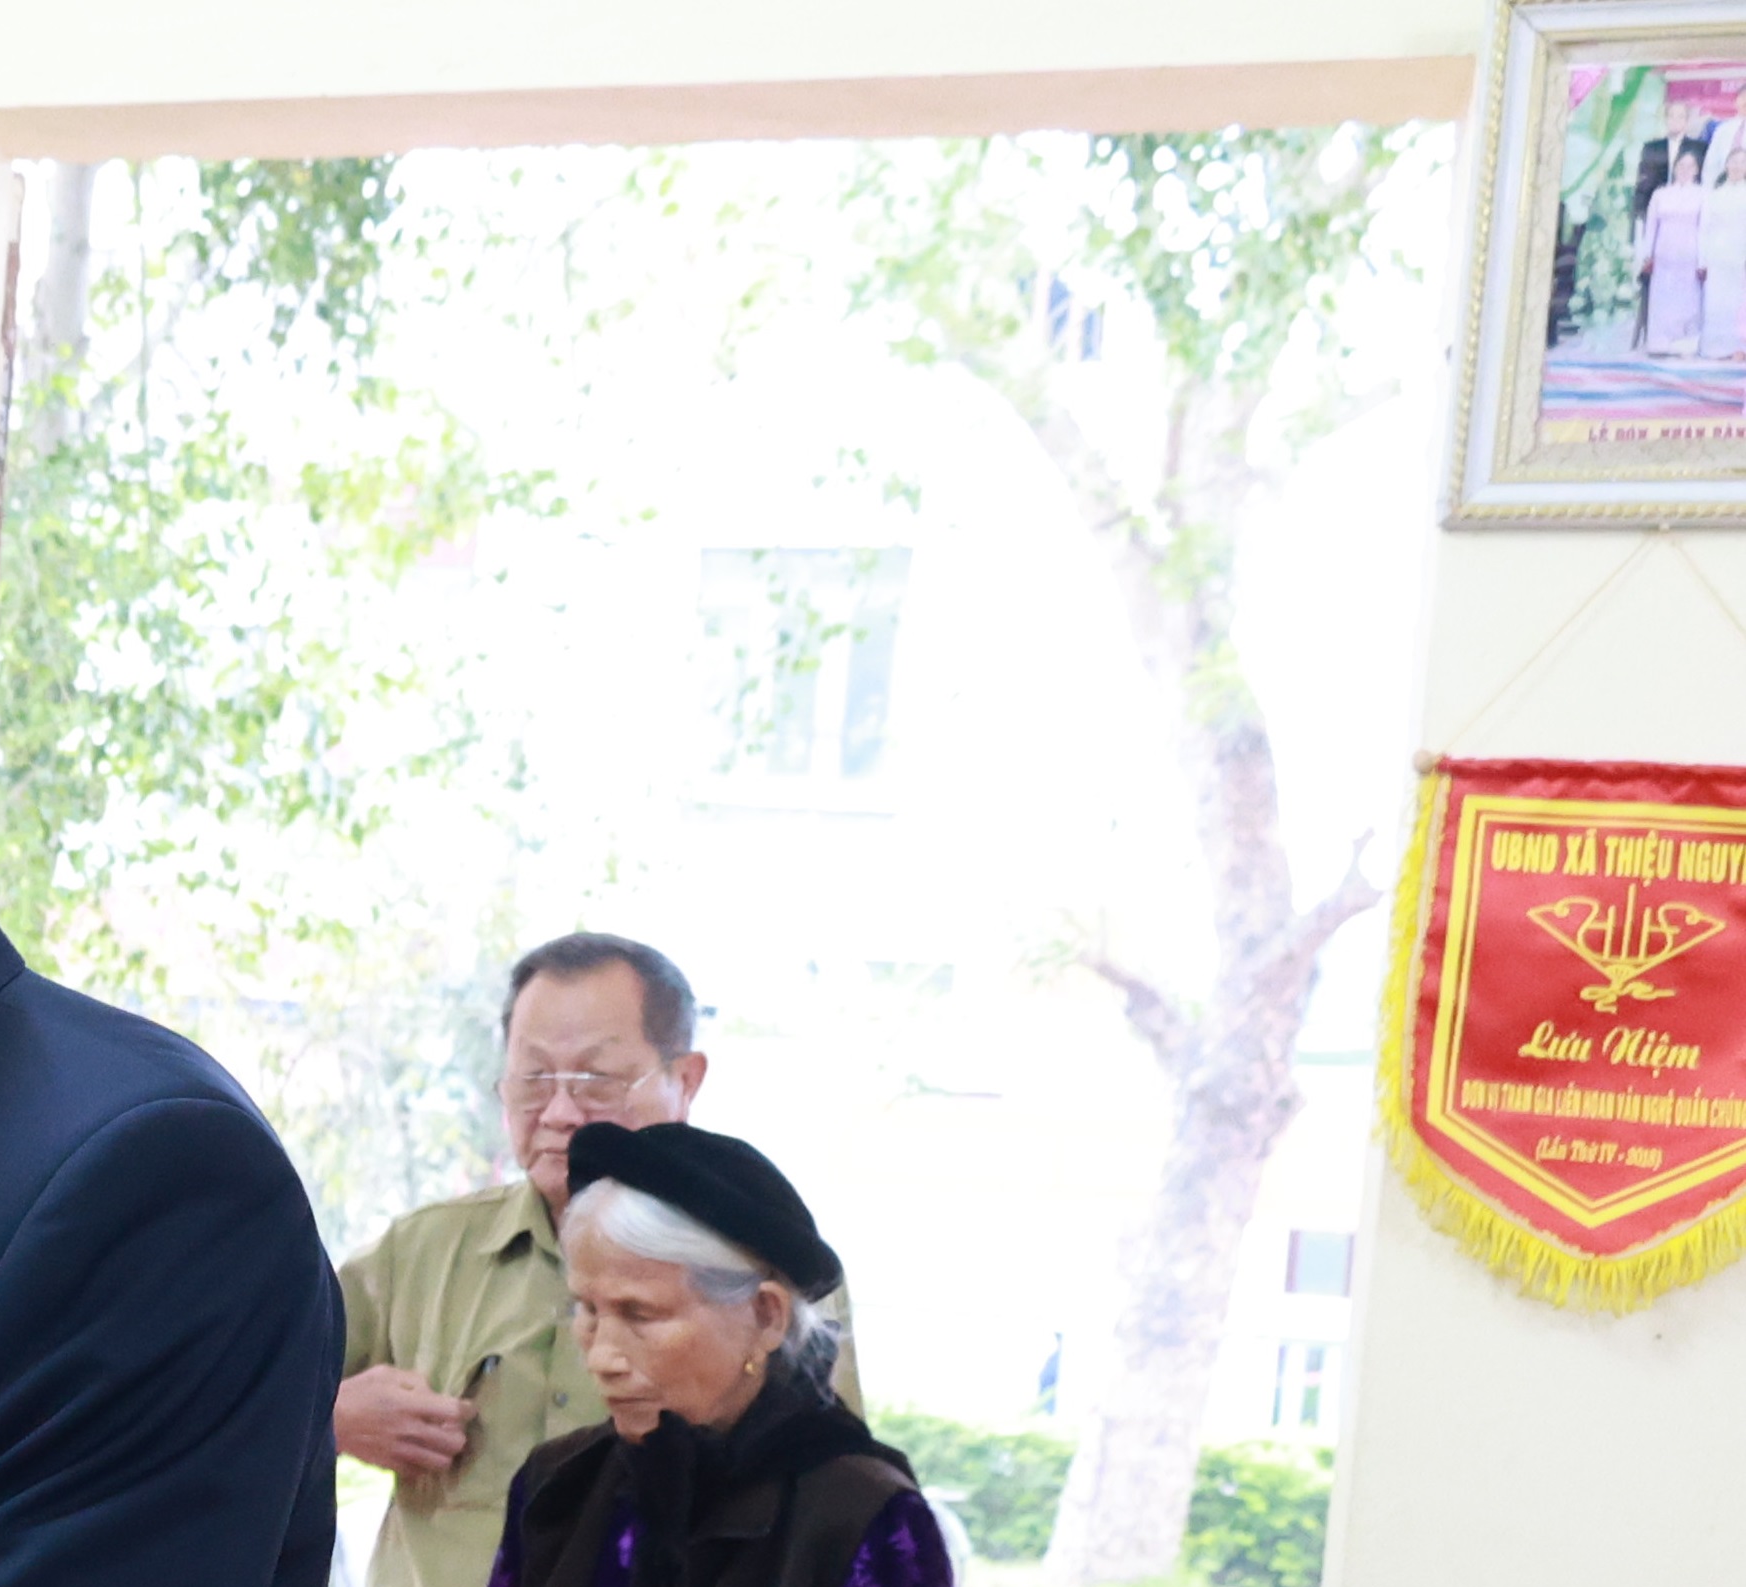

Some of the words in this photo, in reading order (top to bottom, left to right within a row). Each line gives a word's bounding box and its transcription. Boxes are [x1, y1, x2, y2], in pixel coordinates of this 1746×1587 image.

[1491, 830, 1558, 874] UBND
[1563, 828, 1597, 876] XÃ
[1605, 829, 1673, 887] THIỆU
[1678, 840, 1746, 885] NGUY
[1518, 1020, 1593, 1063] Lưu
[1602, 1026, 1700, 1079] Niệm
